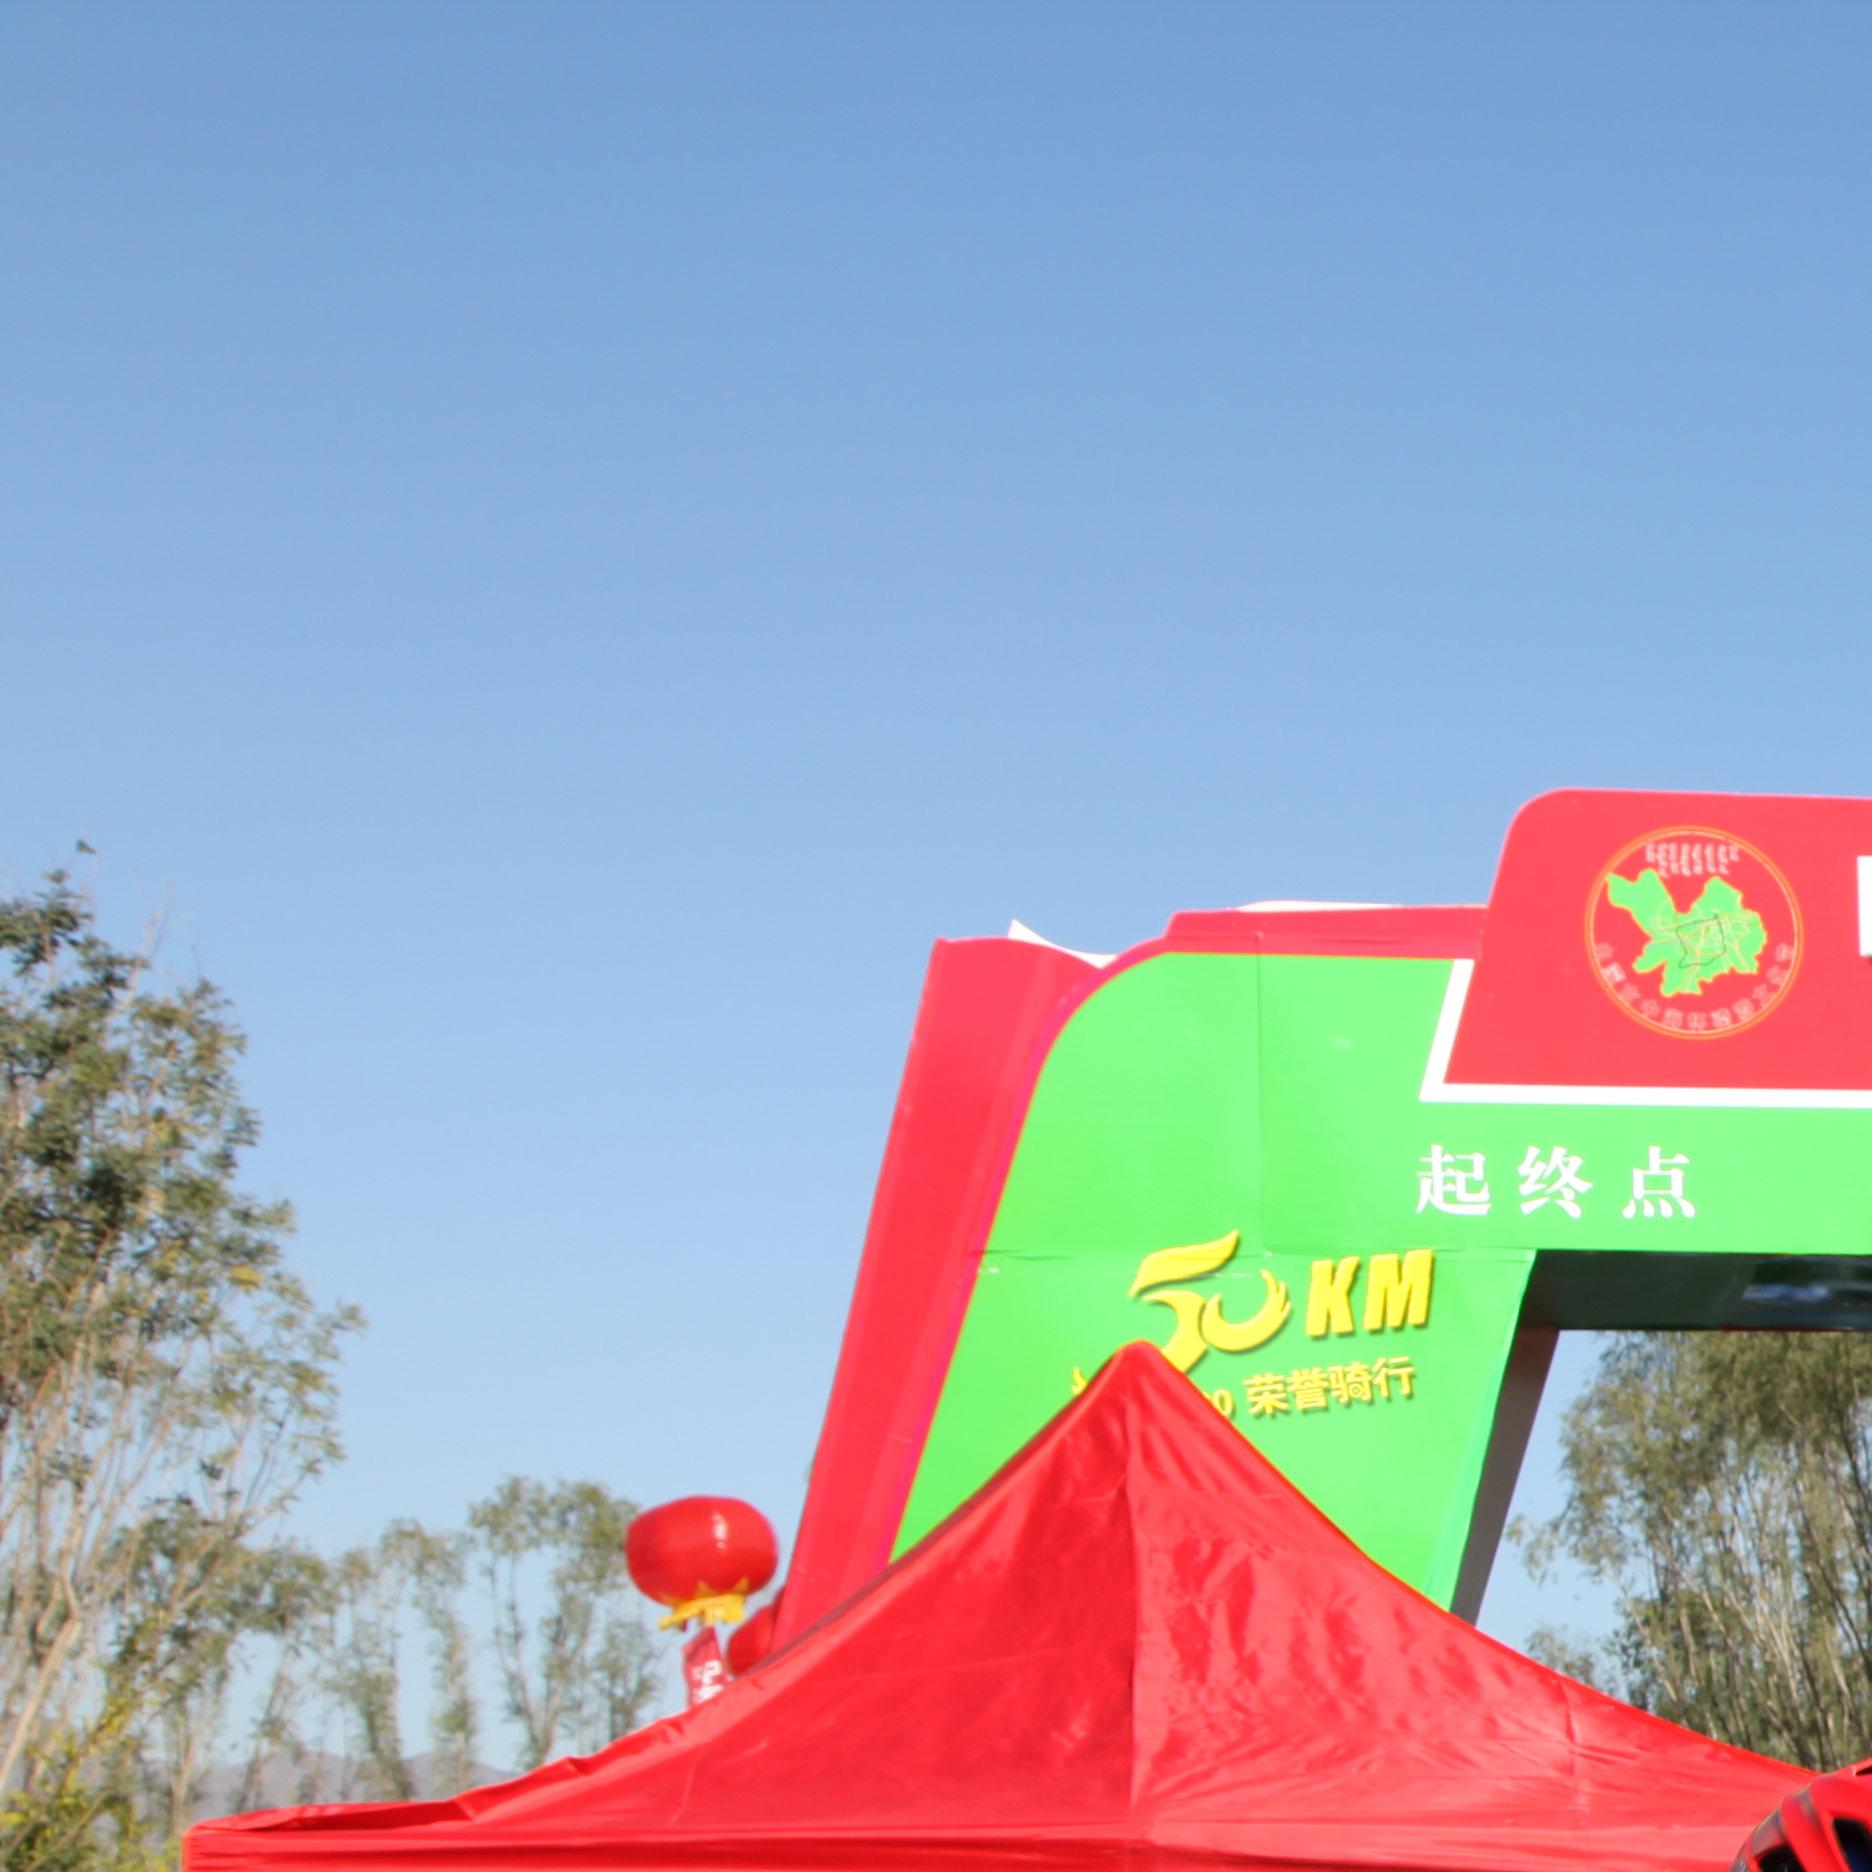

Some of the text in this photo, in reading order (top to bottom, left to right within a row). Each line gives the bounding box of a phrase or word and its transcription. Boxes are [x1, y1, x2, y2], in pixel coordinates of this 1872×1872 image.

[1414, 1144, 1697, 1219] 起终点
[1246, 1355, 1415, 1417] 荣誉骑行
